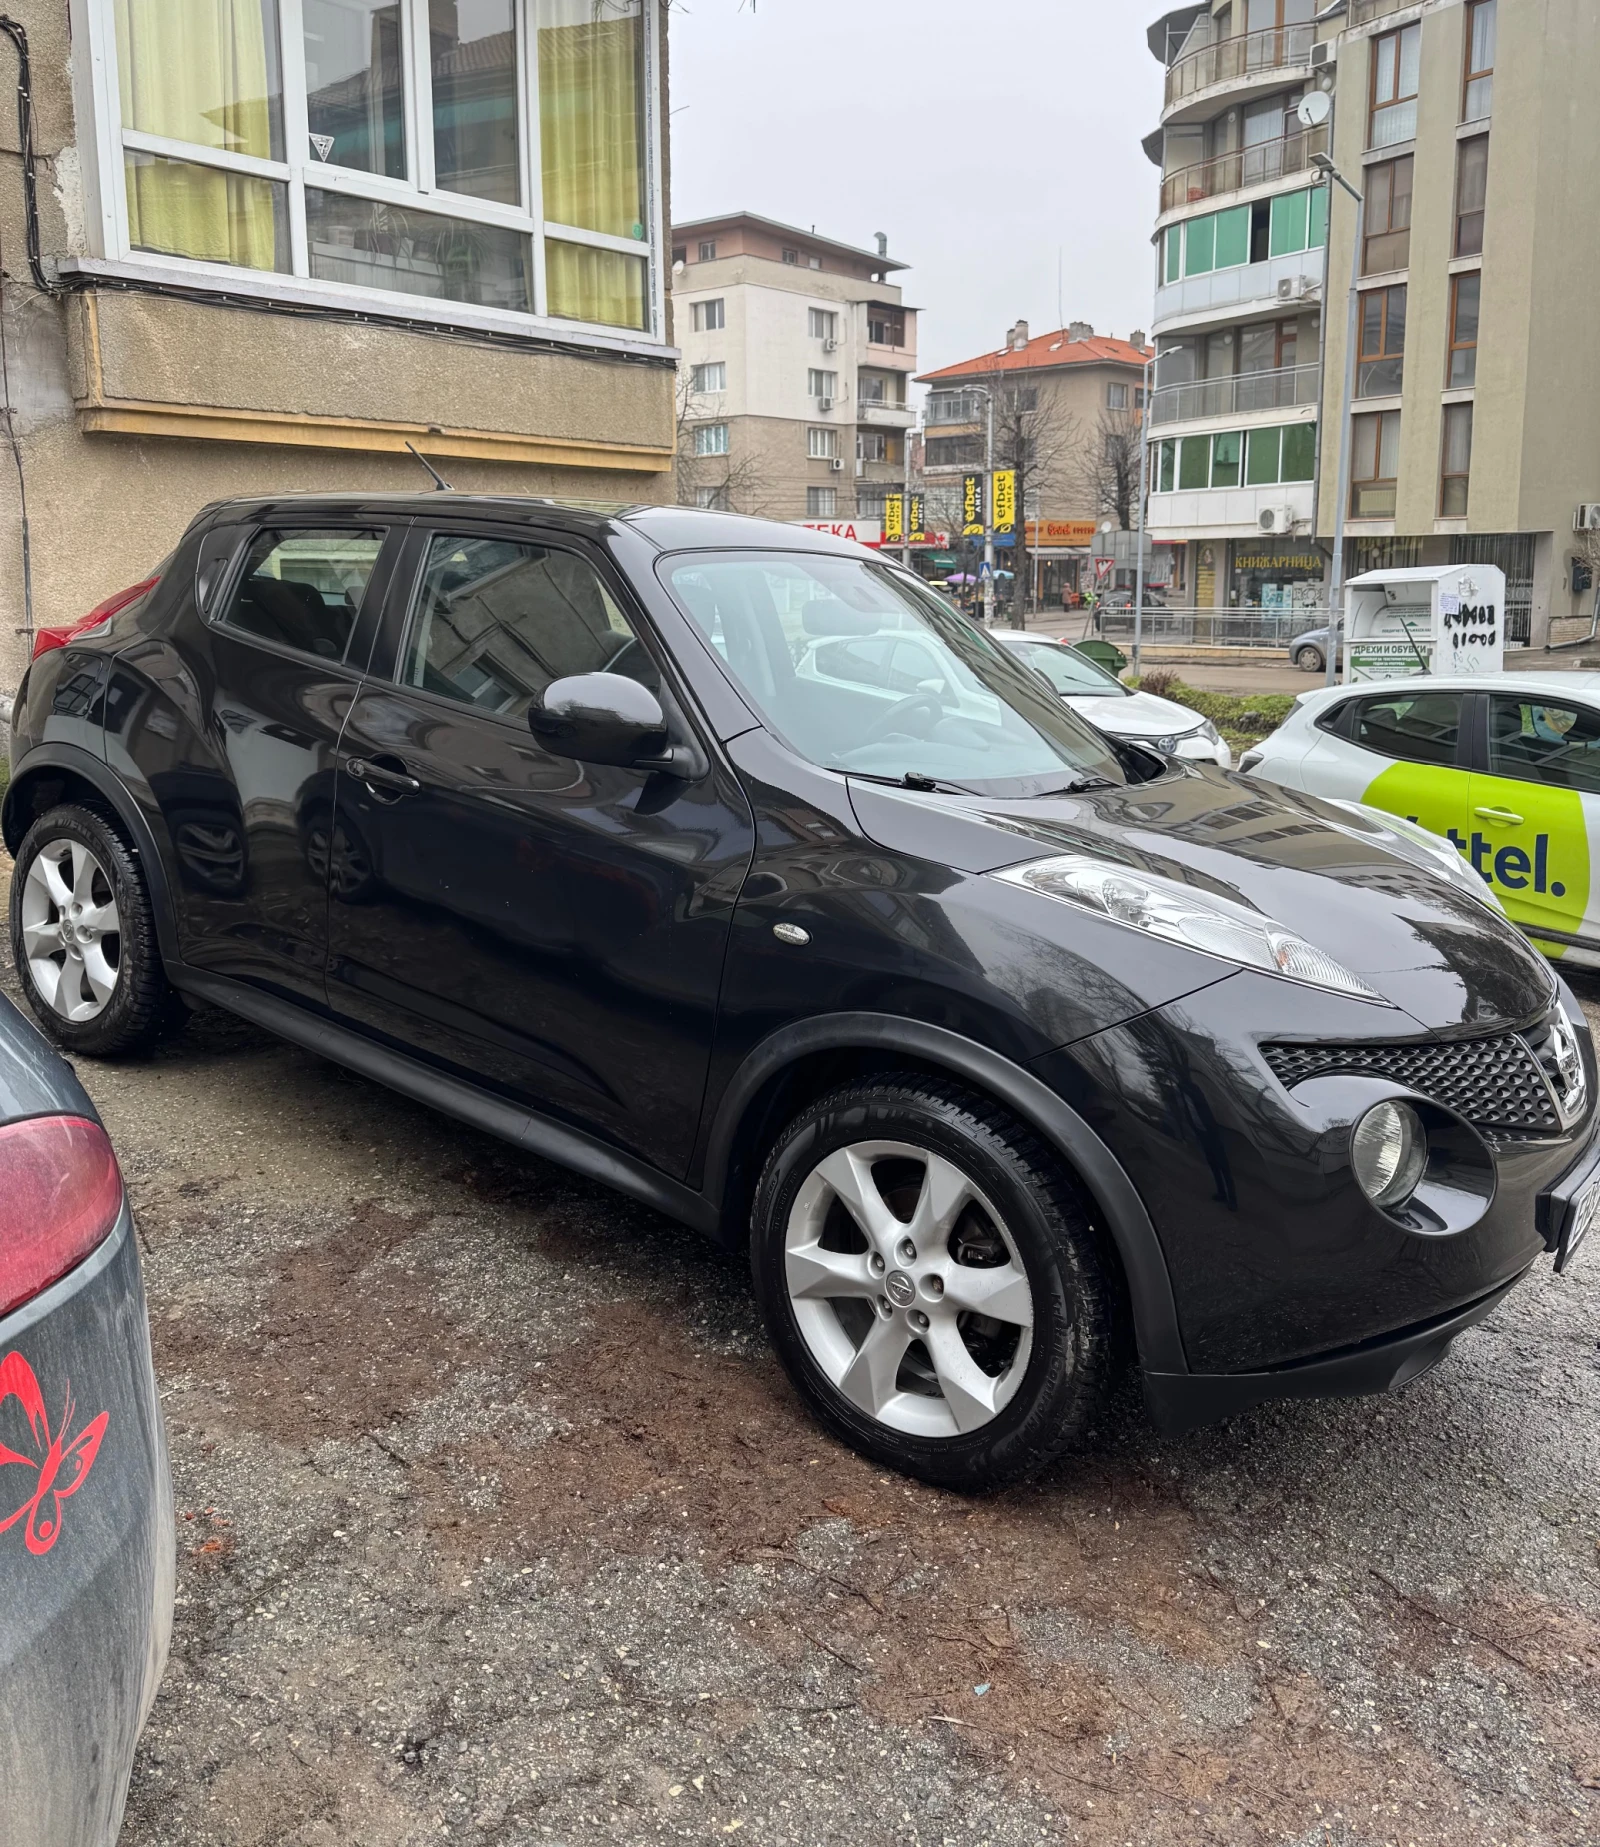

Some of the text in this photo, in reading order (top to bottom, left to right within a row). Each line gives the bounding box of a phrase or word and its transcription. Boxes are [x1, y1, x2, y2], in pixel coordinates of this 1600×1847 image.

[965, 477, 975, 522] efbet
[996, 475, 1006, 519] efbet
[1235, 555, 1322, 570] КНИЖАРНИЦА
[1354, 645, 1426, 655] ДРЕХИ И ОБУВИ
